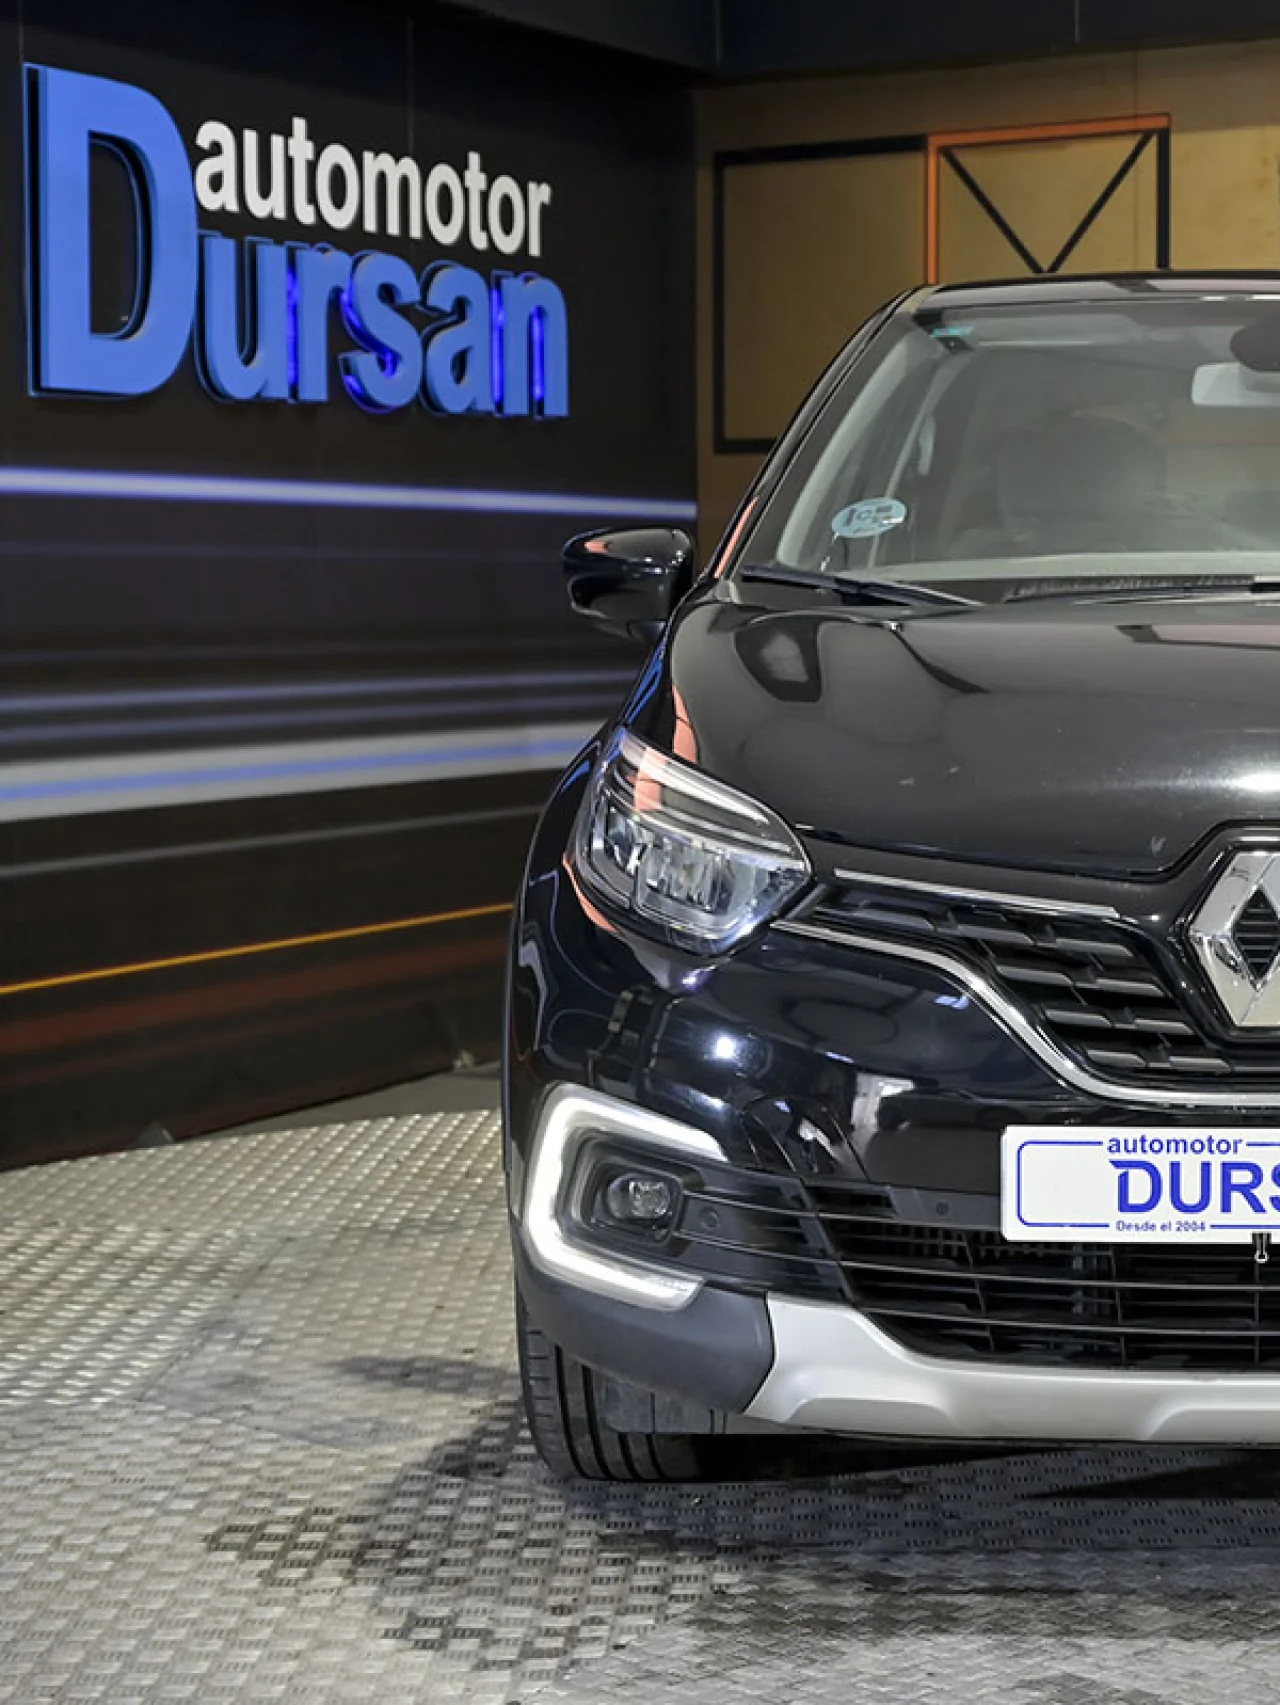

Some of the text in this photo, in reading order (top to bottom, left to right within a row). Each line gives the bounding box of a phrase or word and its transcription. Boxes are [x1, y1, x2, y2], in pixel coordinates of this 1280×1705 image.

[193, 116, 551, 257] automotor
[22, 62, 569, 419] Dursan
[1107, 1135, 1243, 1155] automotor
[1115, 1219, 1157, 1232] Desde
[1160, 1219, 1172, 1232] el
